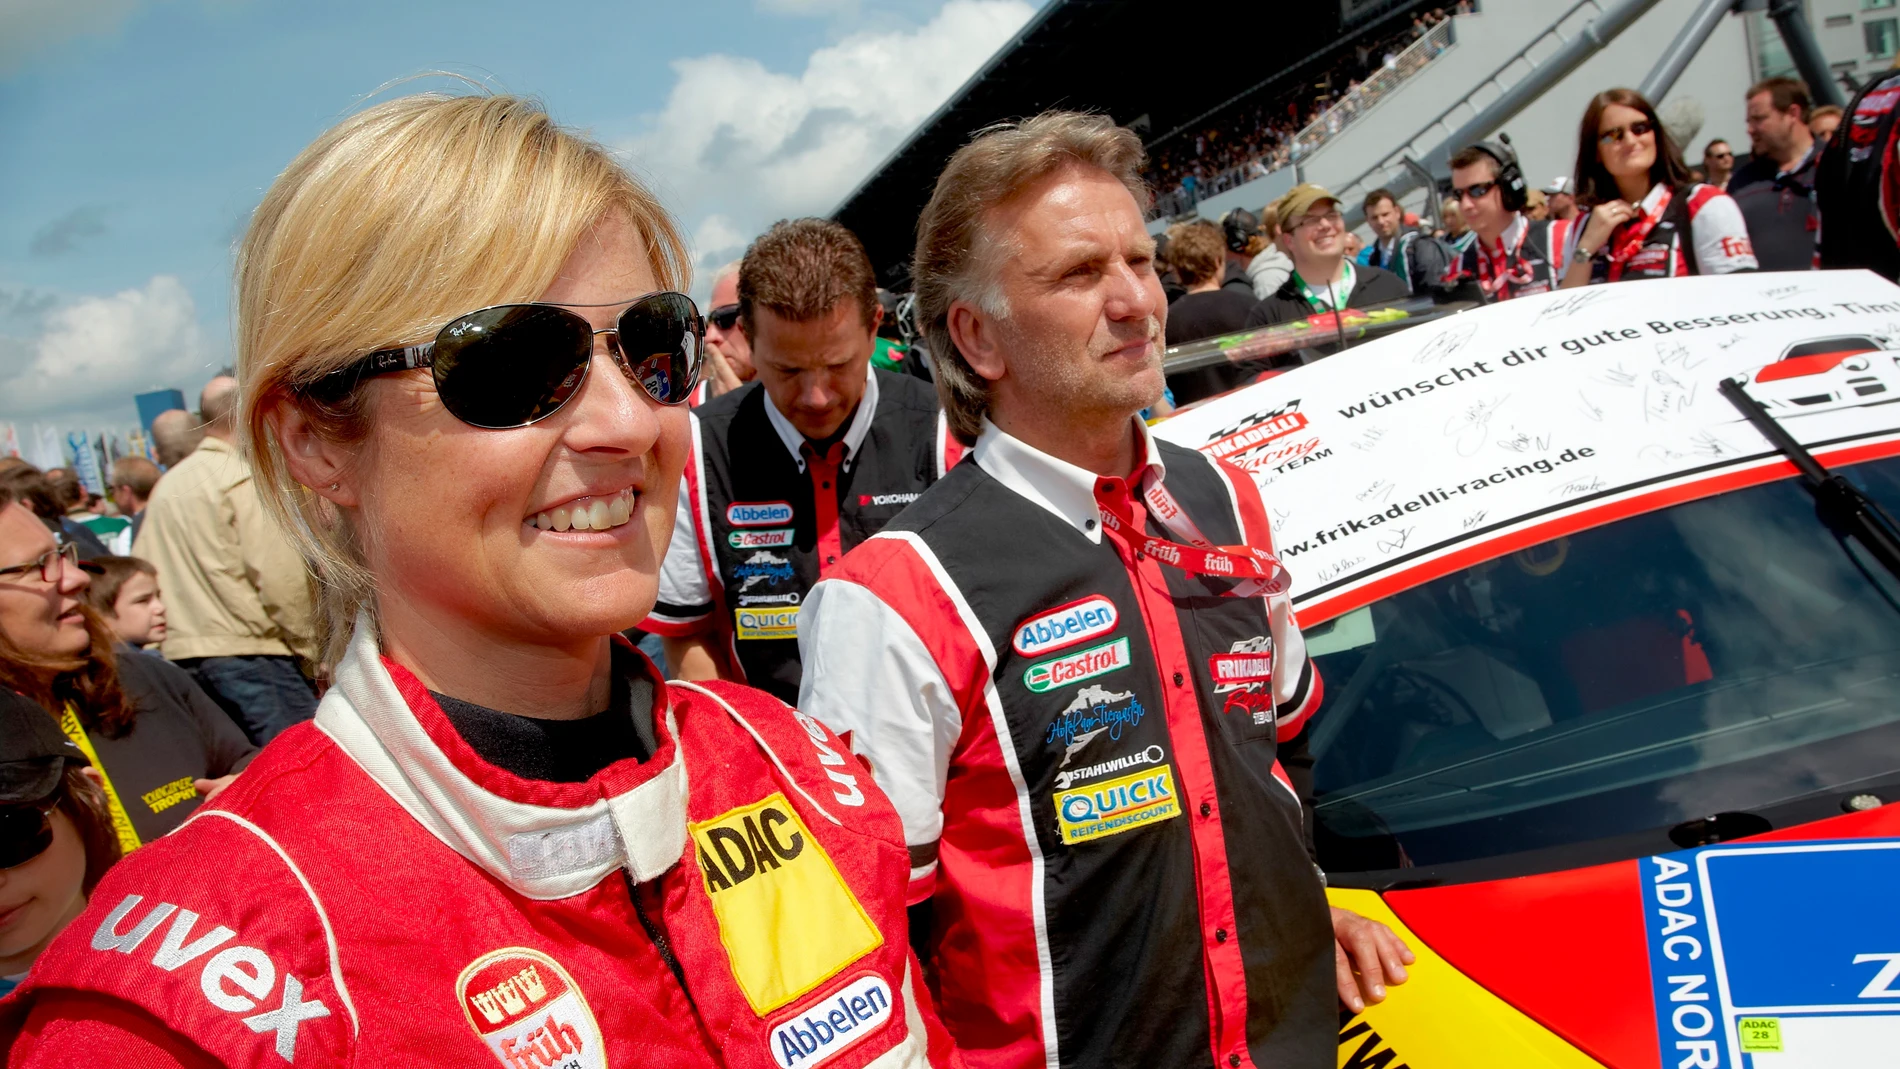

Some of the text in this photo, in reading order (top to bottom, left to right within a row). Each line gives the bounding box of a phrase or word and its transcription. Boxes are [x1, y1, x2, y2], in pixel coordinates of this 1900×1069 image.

[1338, 361, 1494, 419] wünscht
[1501, 345, 1548, 367] dir
[1560, 328, 1642, 355] gute
[1646, 307, 1836, 335] Besserung,
[1272, 448, 1333, 474] TEAM
[732, 507, 789, 521] Abbelen
[872, 492, 922, 506] YOKOHAM
[1279, 447, 1596, 560] w.frikadelli-racing.de
[743, 532, 786, 546] Castrol
[1144, 540, 1181, 565] früh
[1204, 553, 1234, 574] früh
[1021, 606, 1112, 649] Abbelen
[1051, 645, 1119, 684] Castrol
[782, 700, 865, 806] uve
[1072, 751, 1148, 780] STAHLWILLE
[149, 788, 197, 814] TROPHY
[1062, 774, 1170, 823] QUICK
[1070, 804, 1174, 838] REIFENDISCOUNT
[698, 808, 804, 893] ADAC
[91, 894, 331, 1064] uvex
[1652, 856, 1720, 1069] ADAC NOR
[778, 986, 888, 1066] Abbelen
[1743, 1021, 1776, 1029] ADAC
[1752, 1031, 1769, 1040] 28
